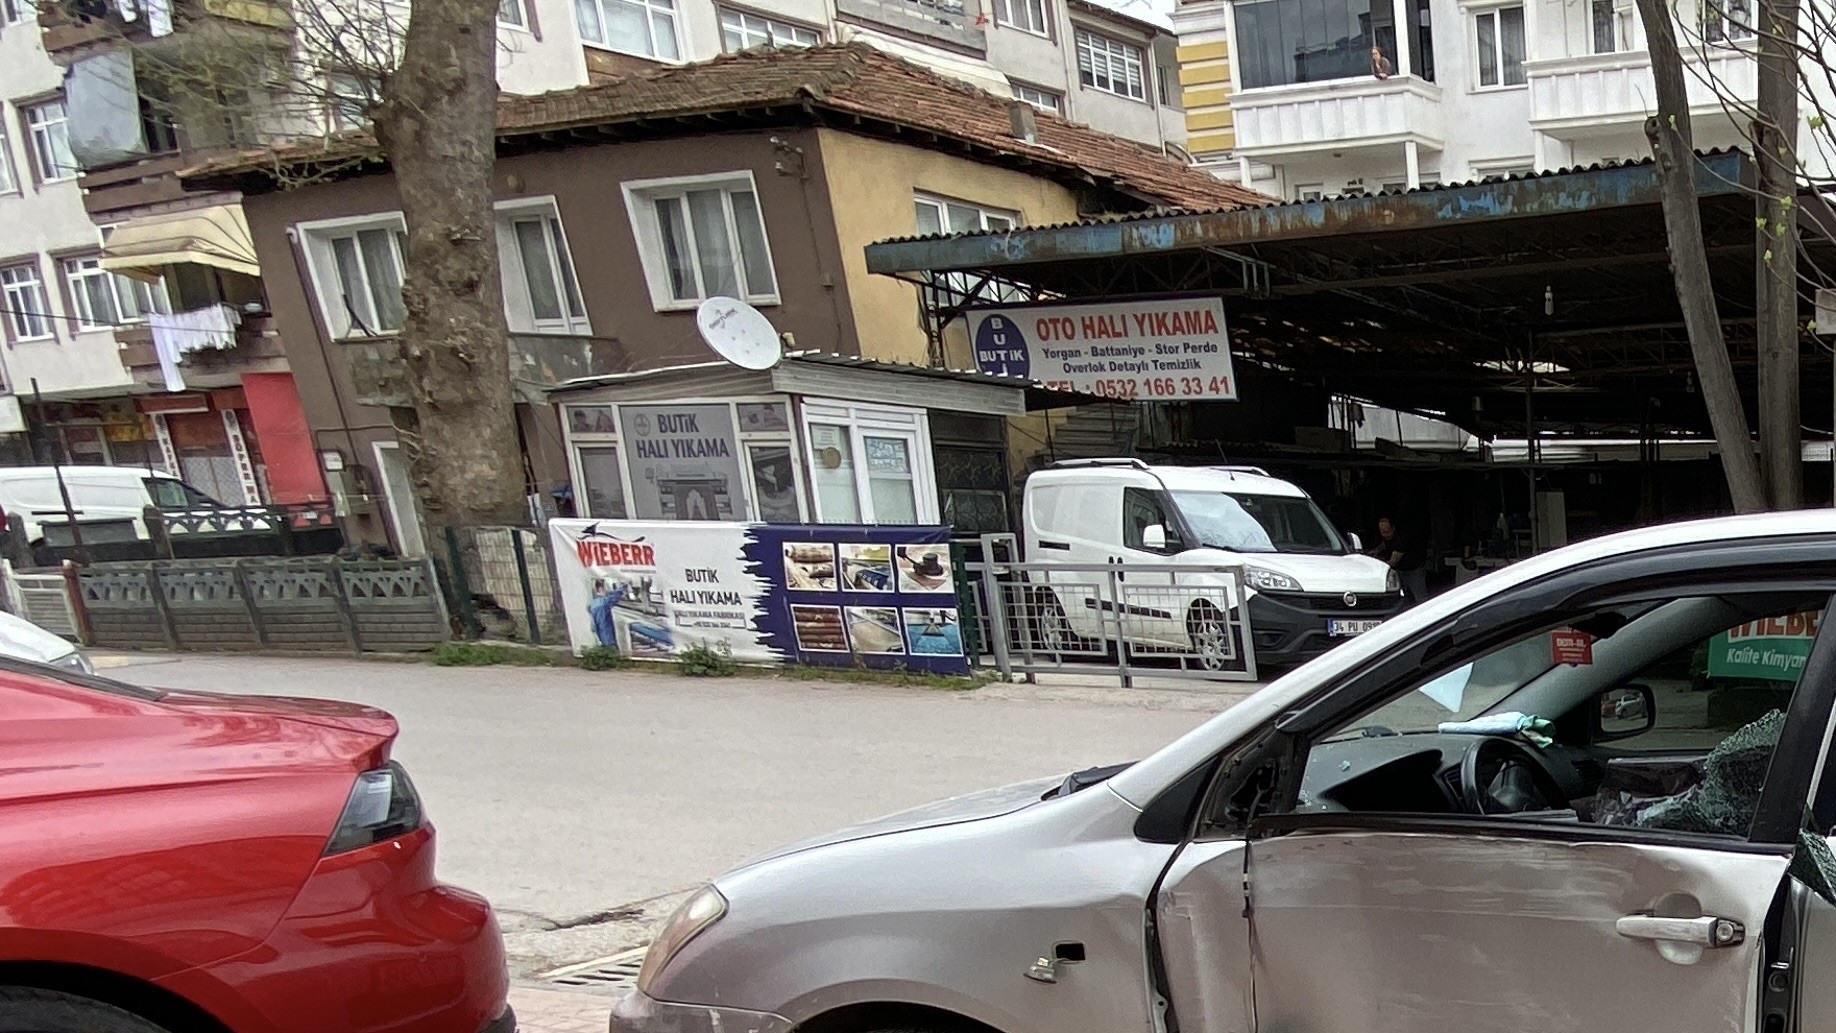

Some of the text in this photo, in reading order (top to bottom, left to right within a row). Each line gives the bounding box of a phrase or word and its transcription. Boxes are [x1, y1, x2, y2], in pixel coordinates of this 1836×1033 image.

[1036, 309, 1219, 341] OTO HALI YIKAMA
[1155, 343, 1179, 355] Stor
[1151, 358, 1202, 371] Temizlik
[1144, 378, 1175, 396] 166
[1181, 377, 1203, 396] 33
[1208, 376, 1230, 395] 41
[635, 438, 730, 458] HALI YIKAMA
[685, 567, 719, 583] BUTİK
[670, 590, 742, 605] HALI YIKAMA
[1726, 646, 1760, 664] Kalite
